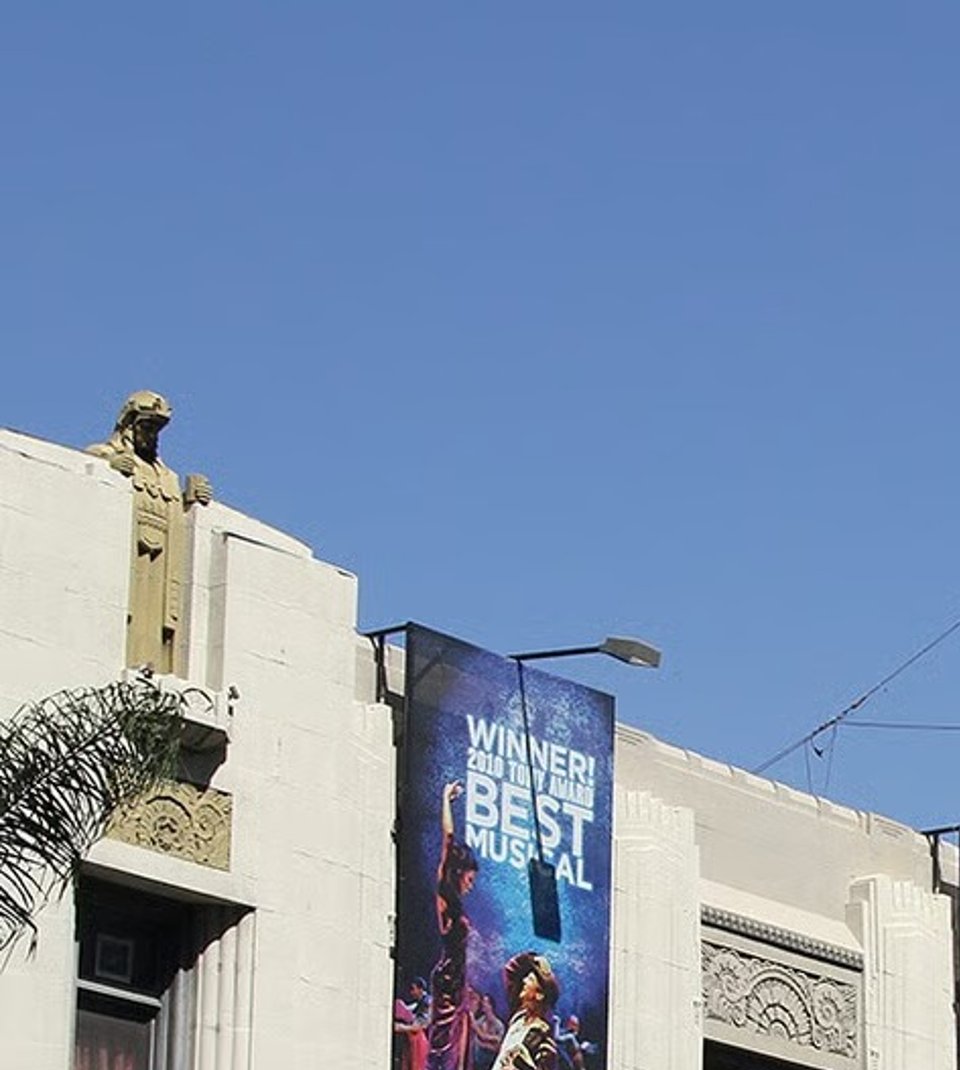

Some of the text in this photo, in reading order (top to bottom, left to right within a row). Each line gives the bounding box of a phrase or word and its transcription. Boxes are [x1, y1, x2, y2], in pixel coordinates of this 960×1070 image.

[466, 713, 596, 786] WINNER!
[466, 746, 504, 779] 2010
[549, 773, 595, 809] AWARD
[465, 771, 594, 857] BEST
